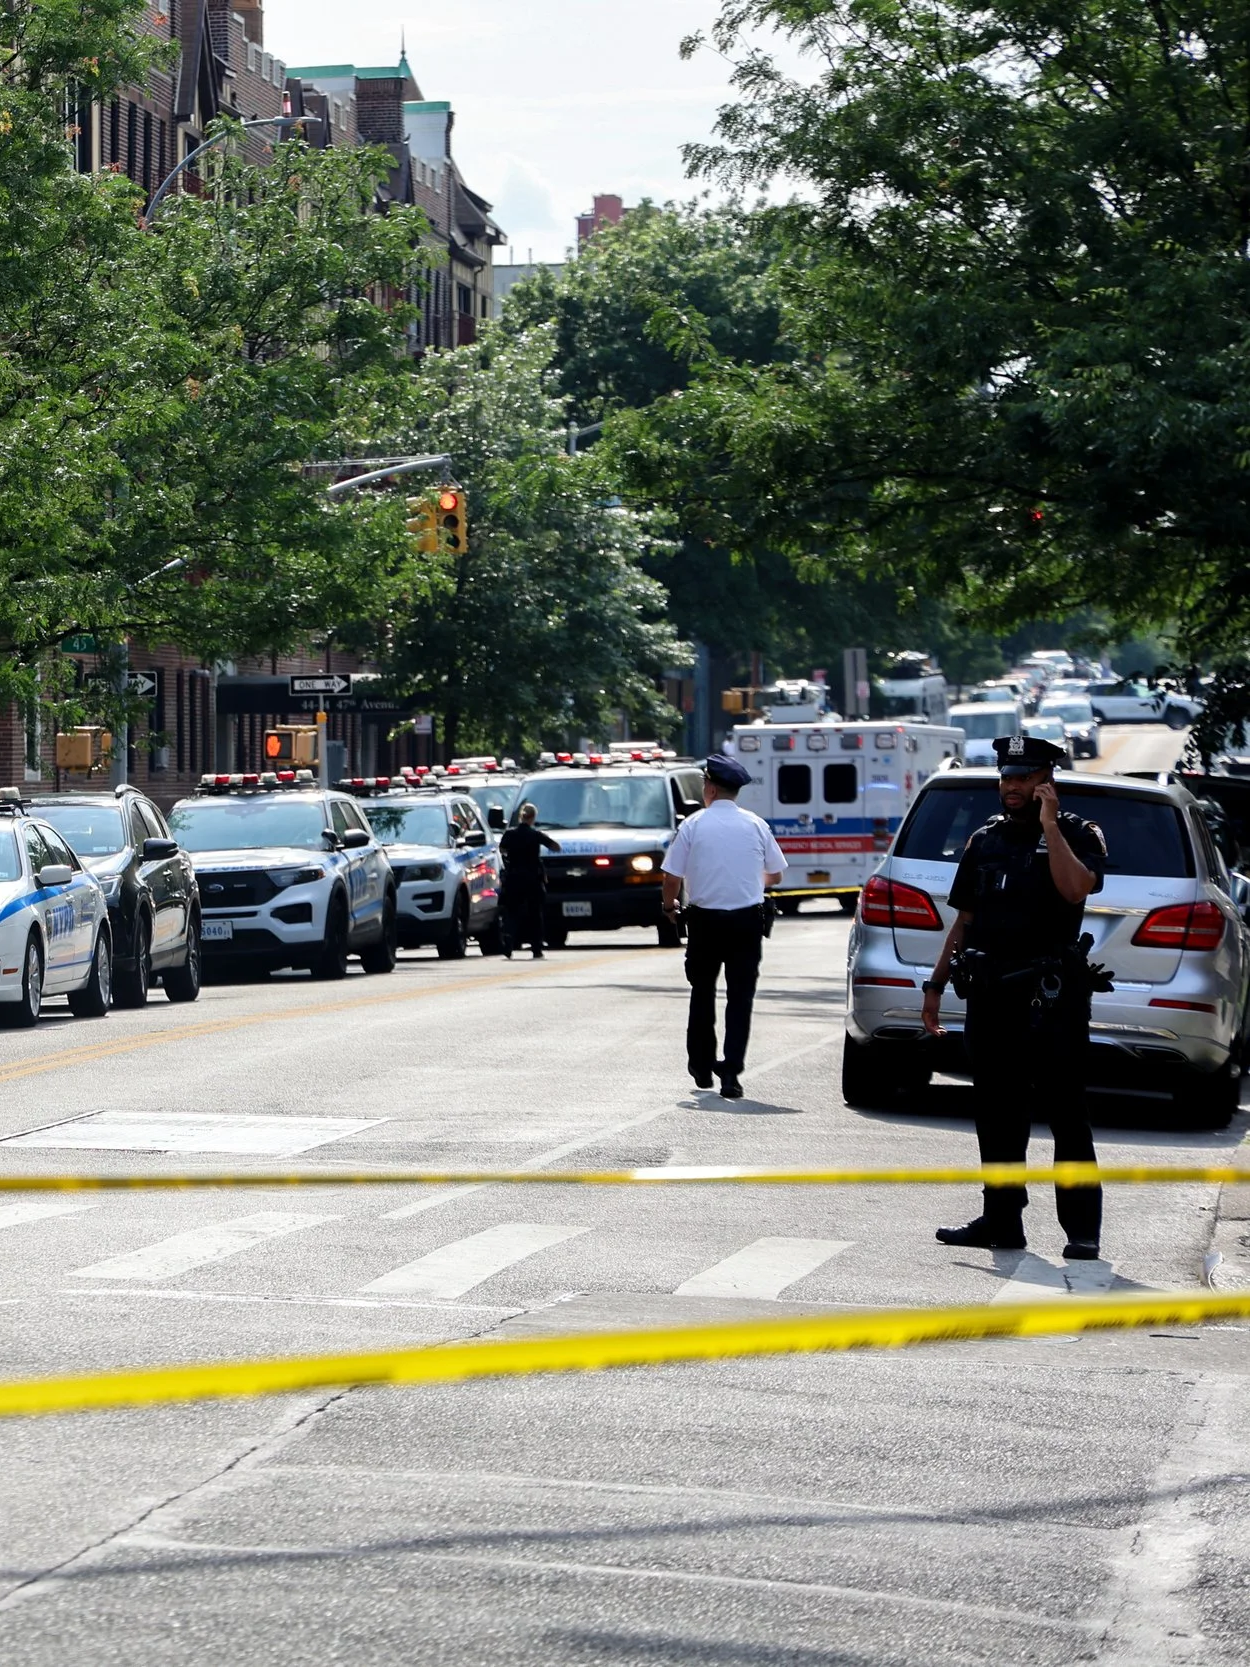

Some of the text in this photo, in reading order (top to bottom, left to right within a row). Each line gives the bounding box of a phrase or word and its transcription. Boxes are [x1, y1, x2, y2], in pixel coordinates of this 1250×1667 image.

[73, 637, 86, 651] 45
[299, 680, 342, 689] ONE WAY
[301, 699, 331, 710] 44-4
[52, 904, 75, 937] NYPD
